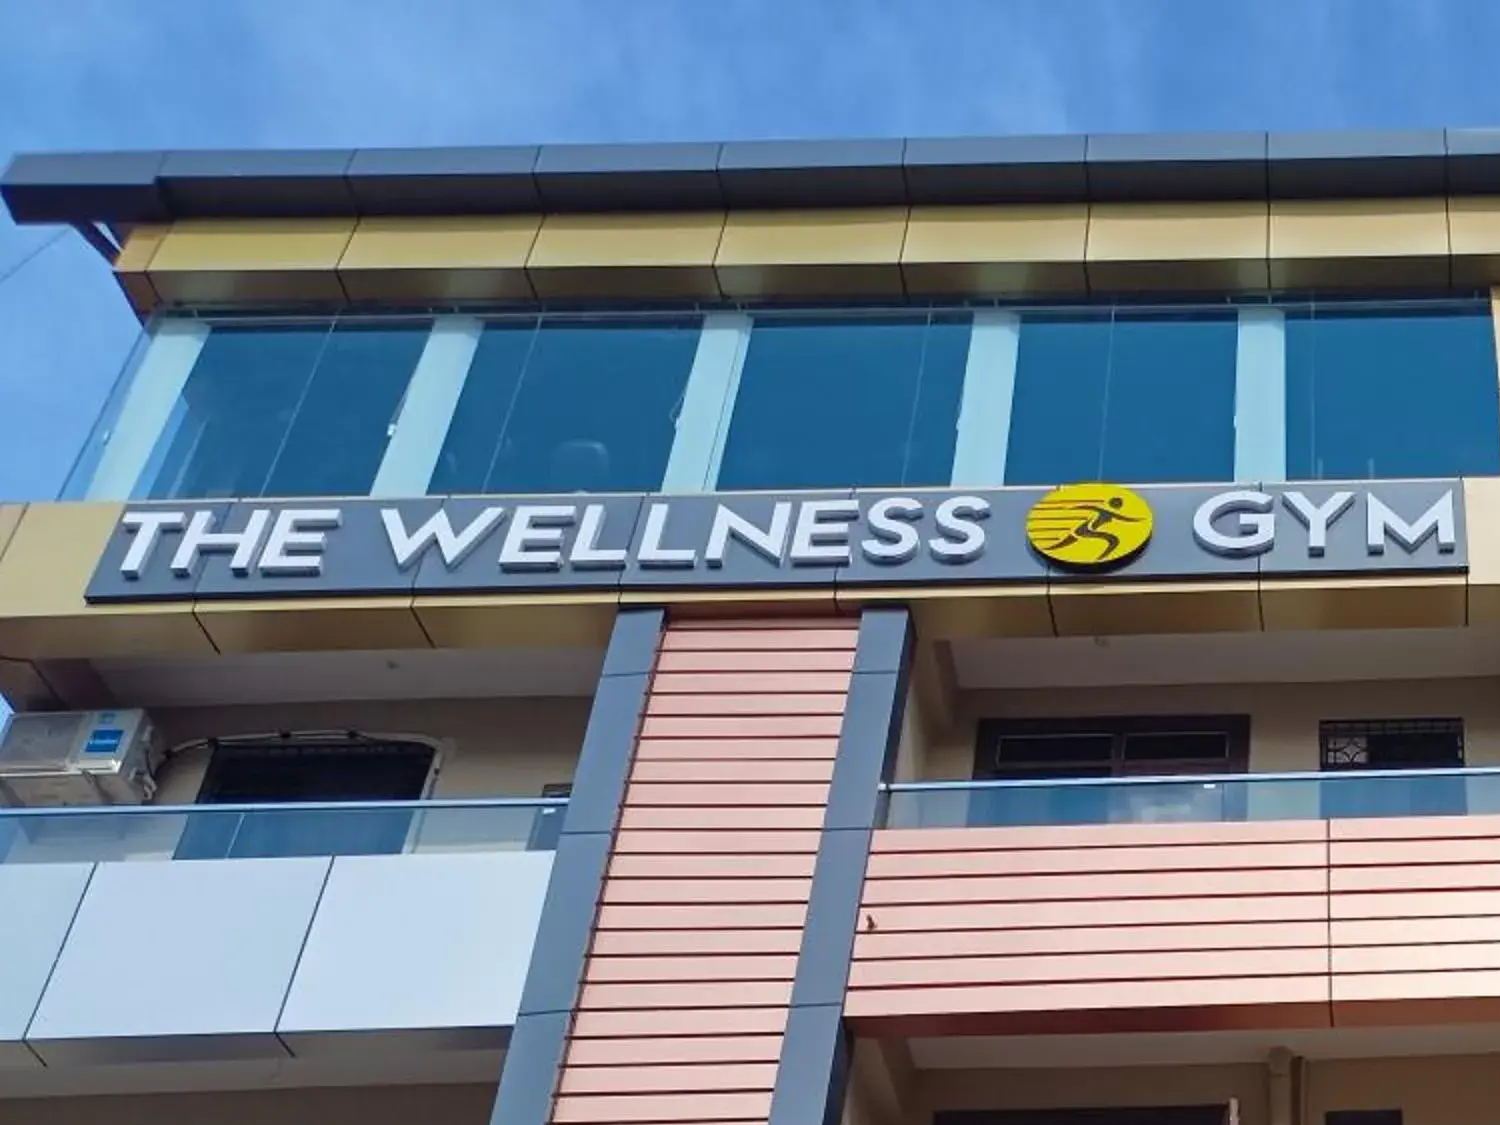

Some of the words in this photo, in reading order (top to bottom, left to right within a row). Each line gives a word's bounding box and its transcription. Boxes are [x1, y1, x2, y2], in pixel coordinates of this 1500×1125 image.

[122, 508, 343, 579] THE
[381, 496, 991, 574] WELLNESS
[1192, 488, 1456, 558] GYM
